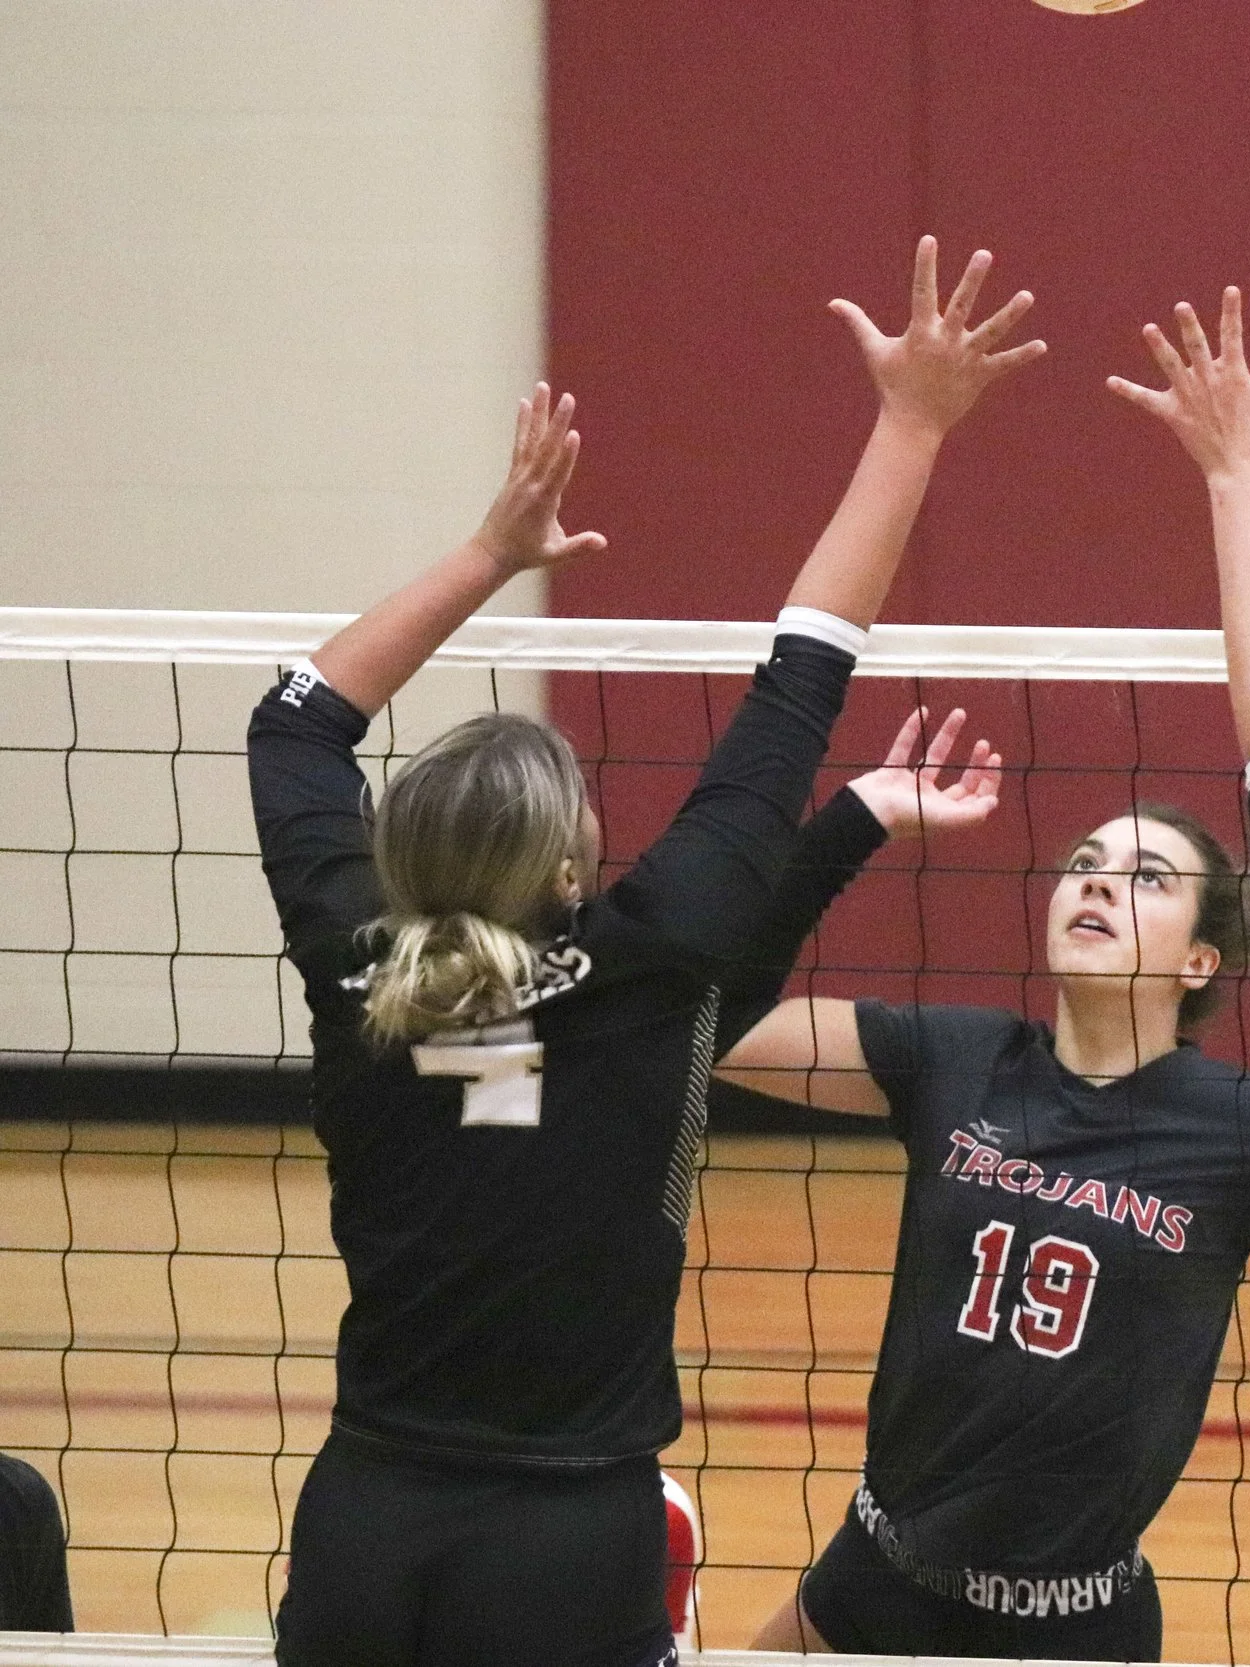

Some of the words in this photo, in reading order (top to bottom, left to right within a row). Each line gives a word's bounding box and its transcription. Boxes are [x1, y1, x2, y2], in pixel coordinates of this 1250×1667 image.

[940, 1128, 1194, 1253] TROJANS
[957, 1219, 1100, 1359] 19
[965, 1567, 1117, 1618] ARMOUR
